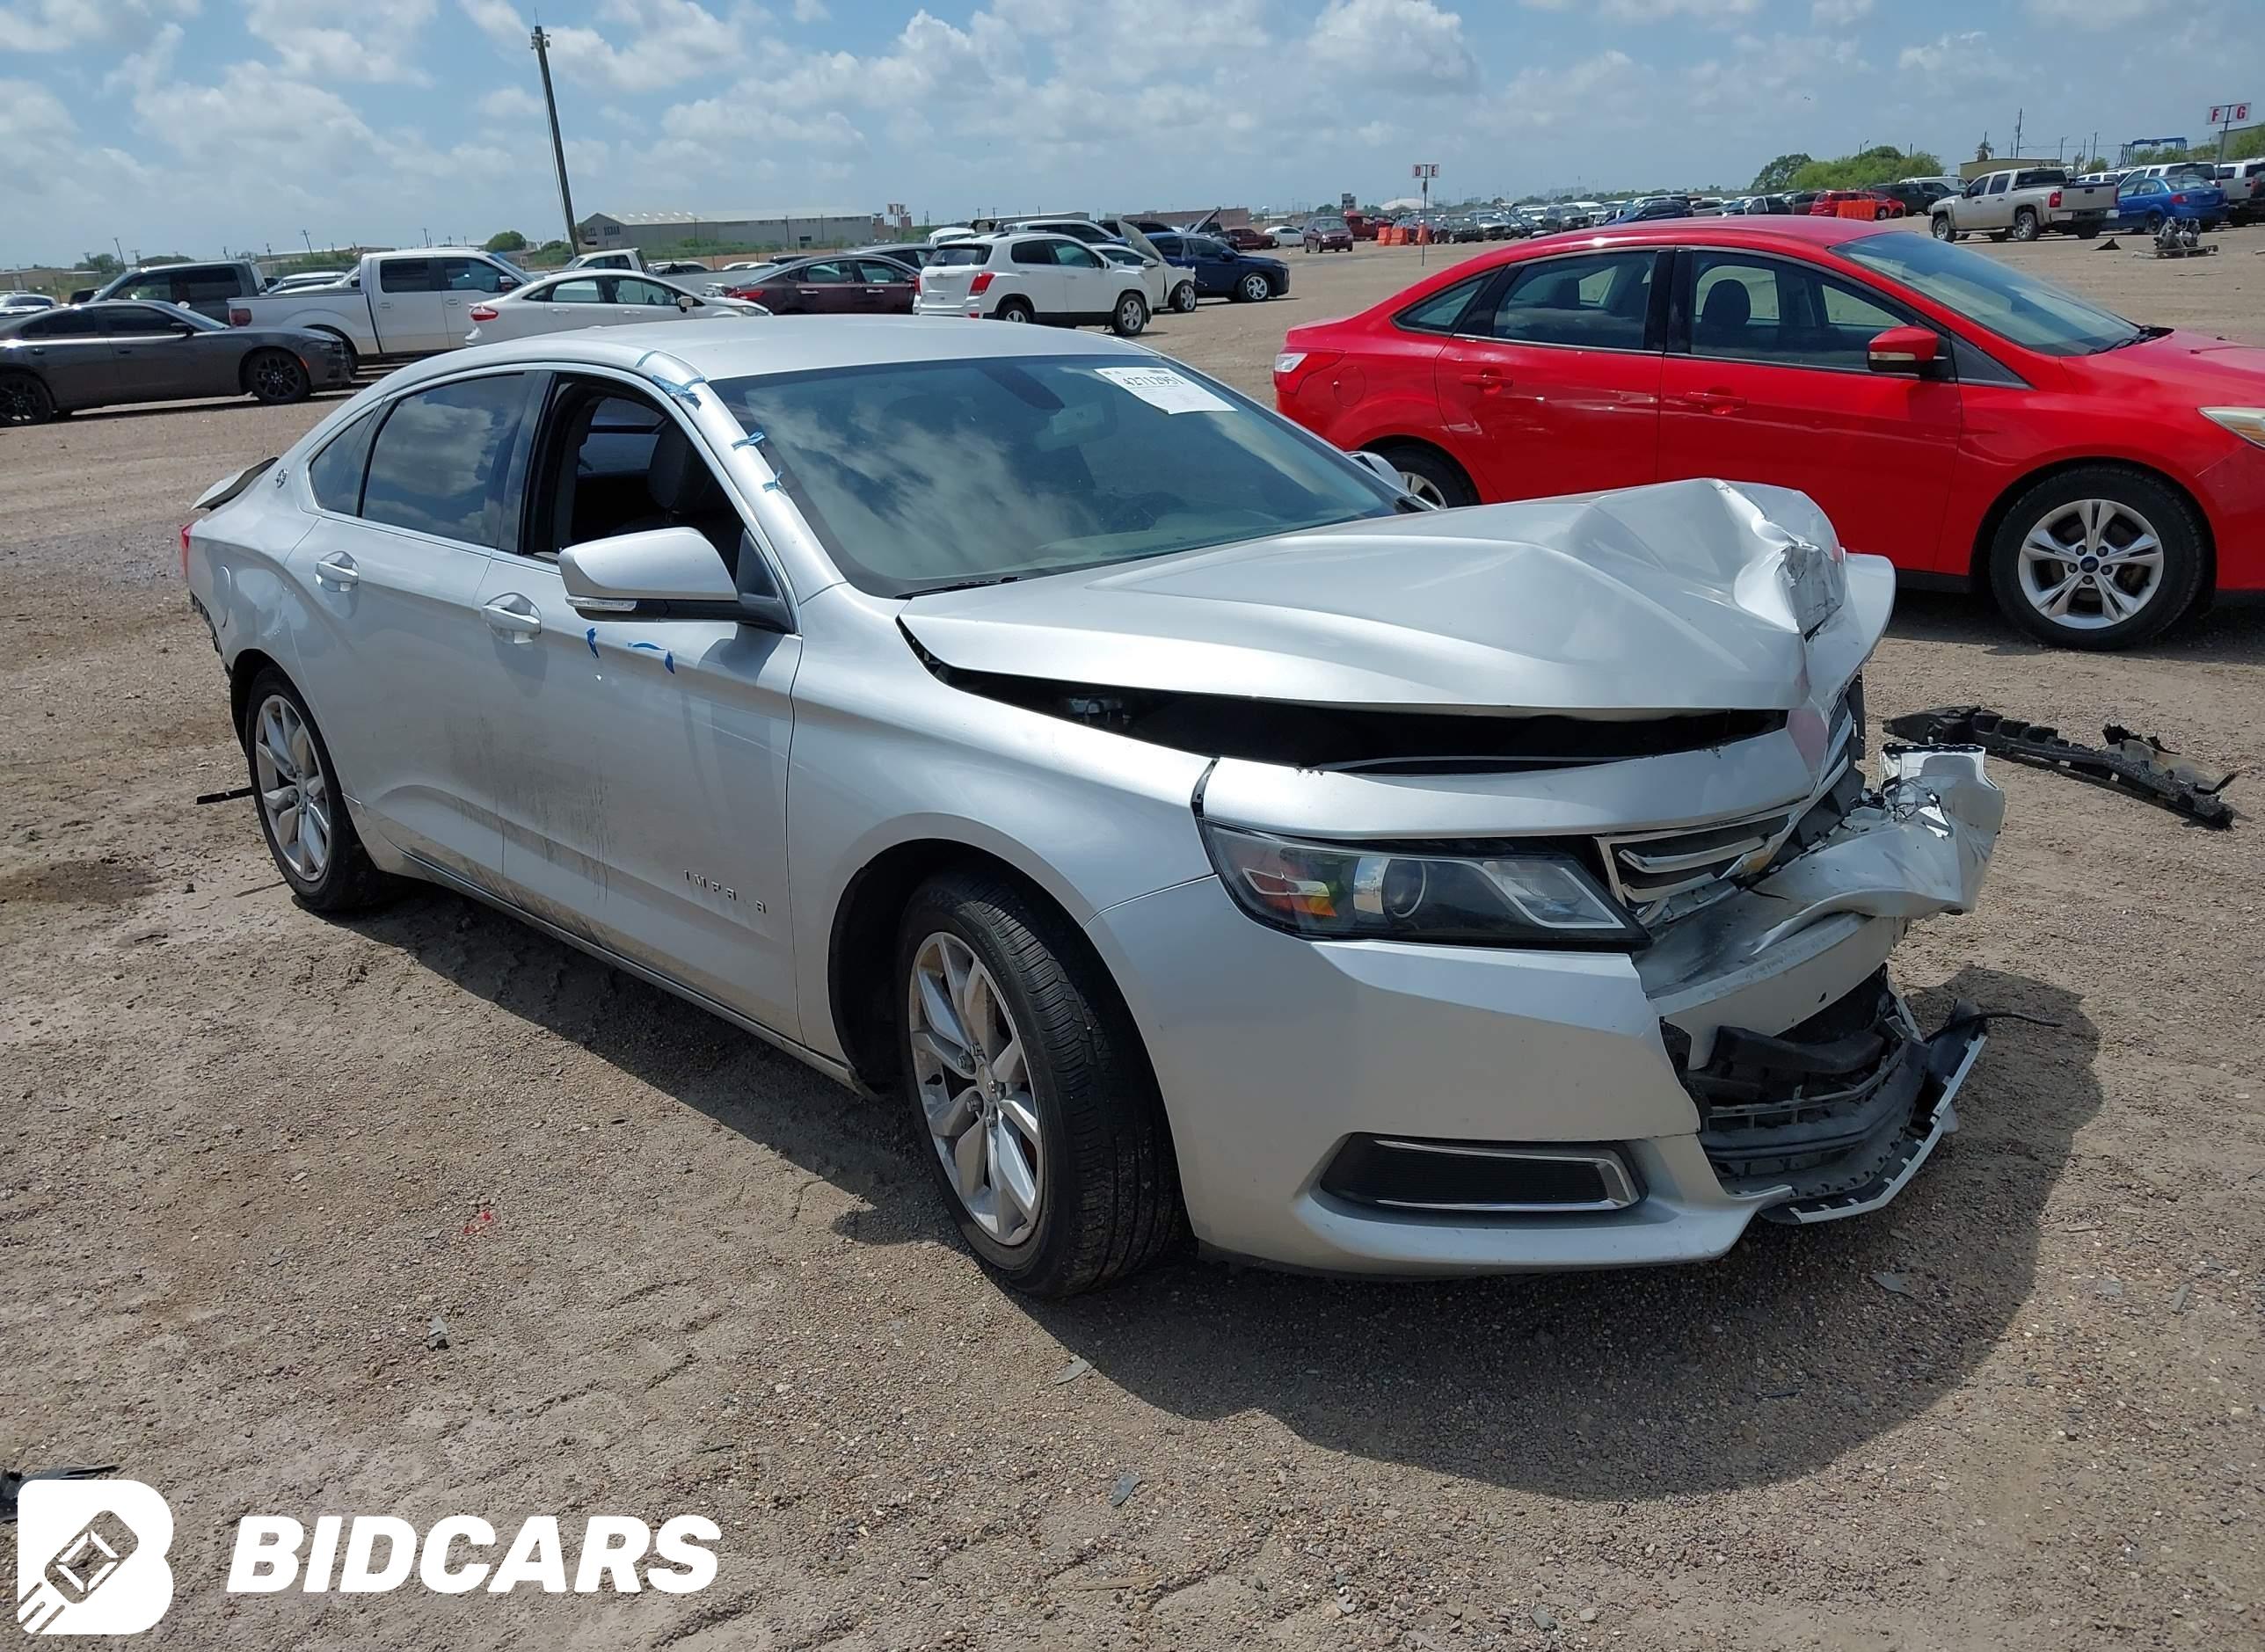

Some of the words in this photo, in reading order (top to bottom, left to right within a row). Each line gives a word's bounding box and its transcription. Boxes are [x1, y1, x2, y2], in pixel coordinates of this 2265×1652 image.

[2211, 108, 2220, 121] F
[2236, 106, 2247, 120] G
[683, 870, 767, 914] IMPAA
